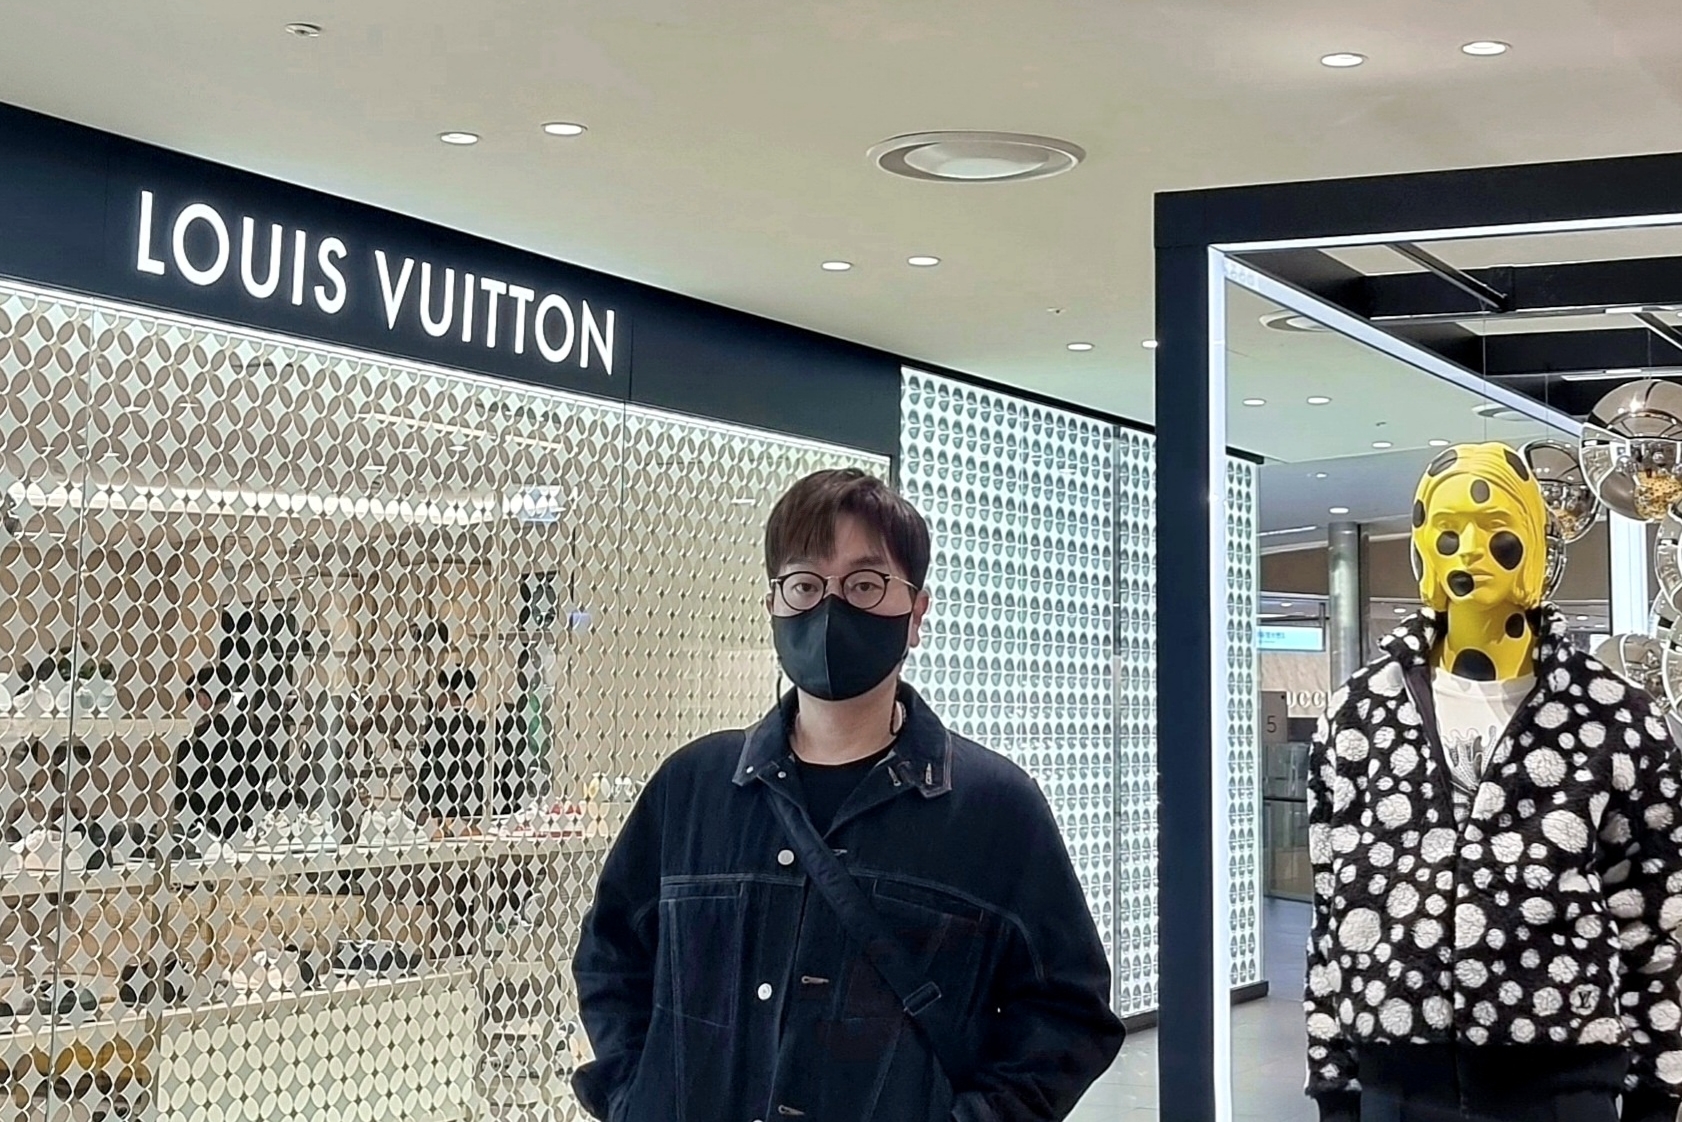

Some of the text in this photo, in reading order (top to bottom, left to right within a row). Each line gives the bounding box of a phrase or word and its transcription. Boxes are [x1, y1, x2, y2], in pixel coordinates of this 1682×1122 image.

[137, 190, 615, 376] LOUIS VUITTON
[1266, 715, 1277, 733] 5
